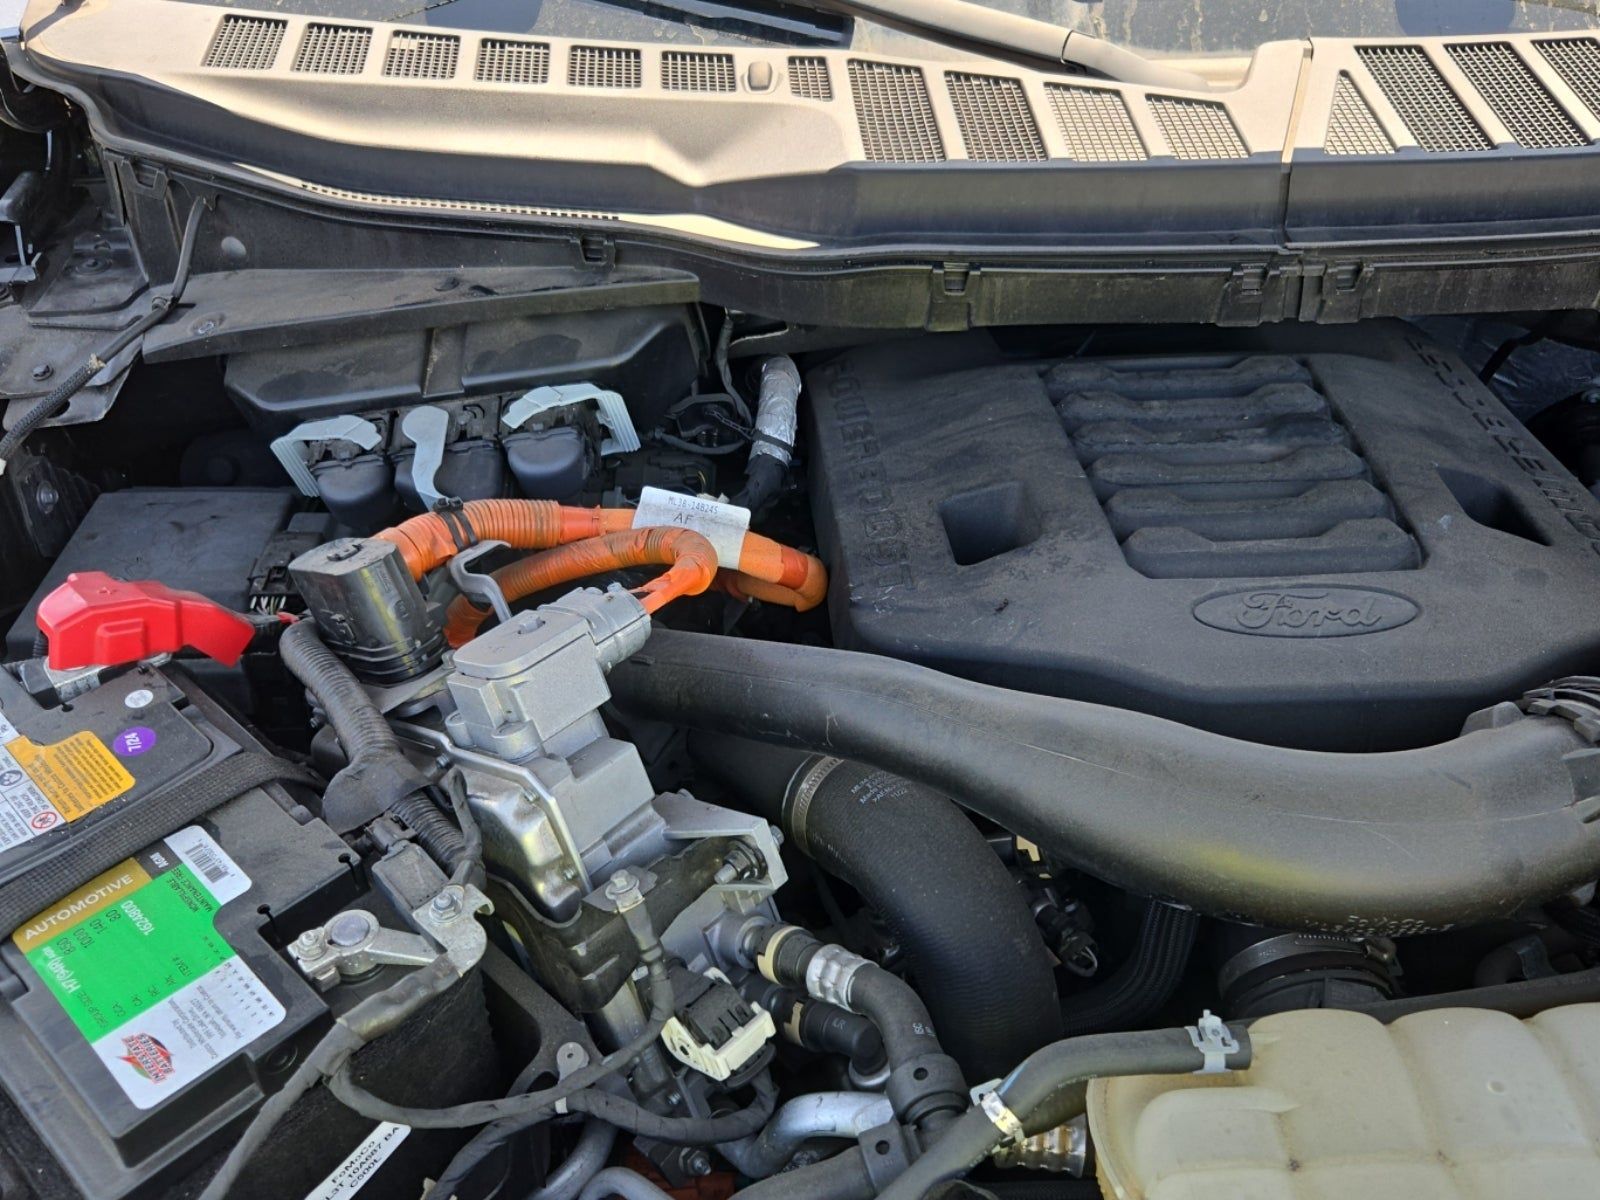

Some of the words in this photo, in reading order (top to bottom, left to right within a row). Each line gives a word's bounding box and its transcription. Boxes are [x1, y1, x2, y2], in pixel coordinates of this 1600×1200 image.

[673, 513, 695, 524] AF
[1236, 593, 1381, 629] Ford
[125, 732, 143, 752] 7/24
[148, 851, 169, 868] AGM
[24, 872, 134, 941] AUTOMOTIVE
[180, 878, 212, 912] MAINTENANCE
[88, 917, 107, 935] 140
[104, 908, 122, 923] 80
[120, 898, 155, 935] 1624800
[122, 1036, 167, 1083] INTERSTATE
[135, 1032, 174, 1075] BATTERIES
[332, 1141, 375, 1184] FoMoCo
[348, 1143, 381, 1178] 10A687
[384, 1127, 399, 1141] BA
[350, 1157, 382, 1188] C500L
